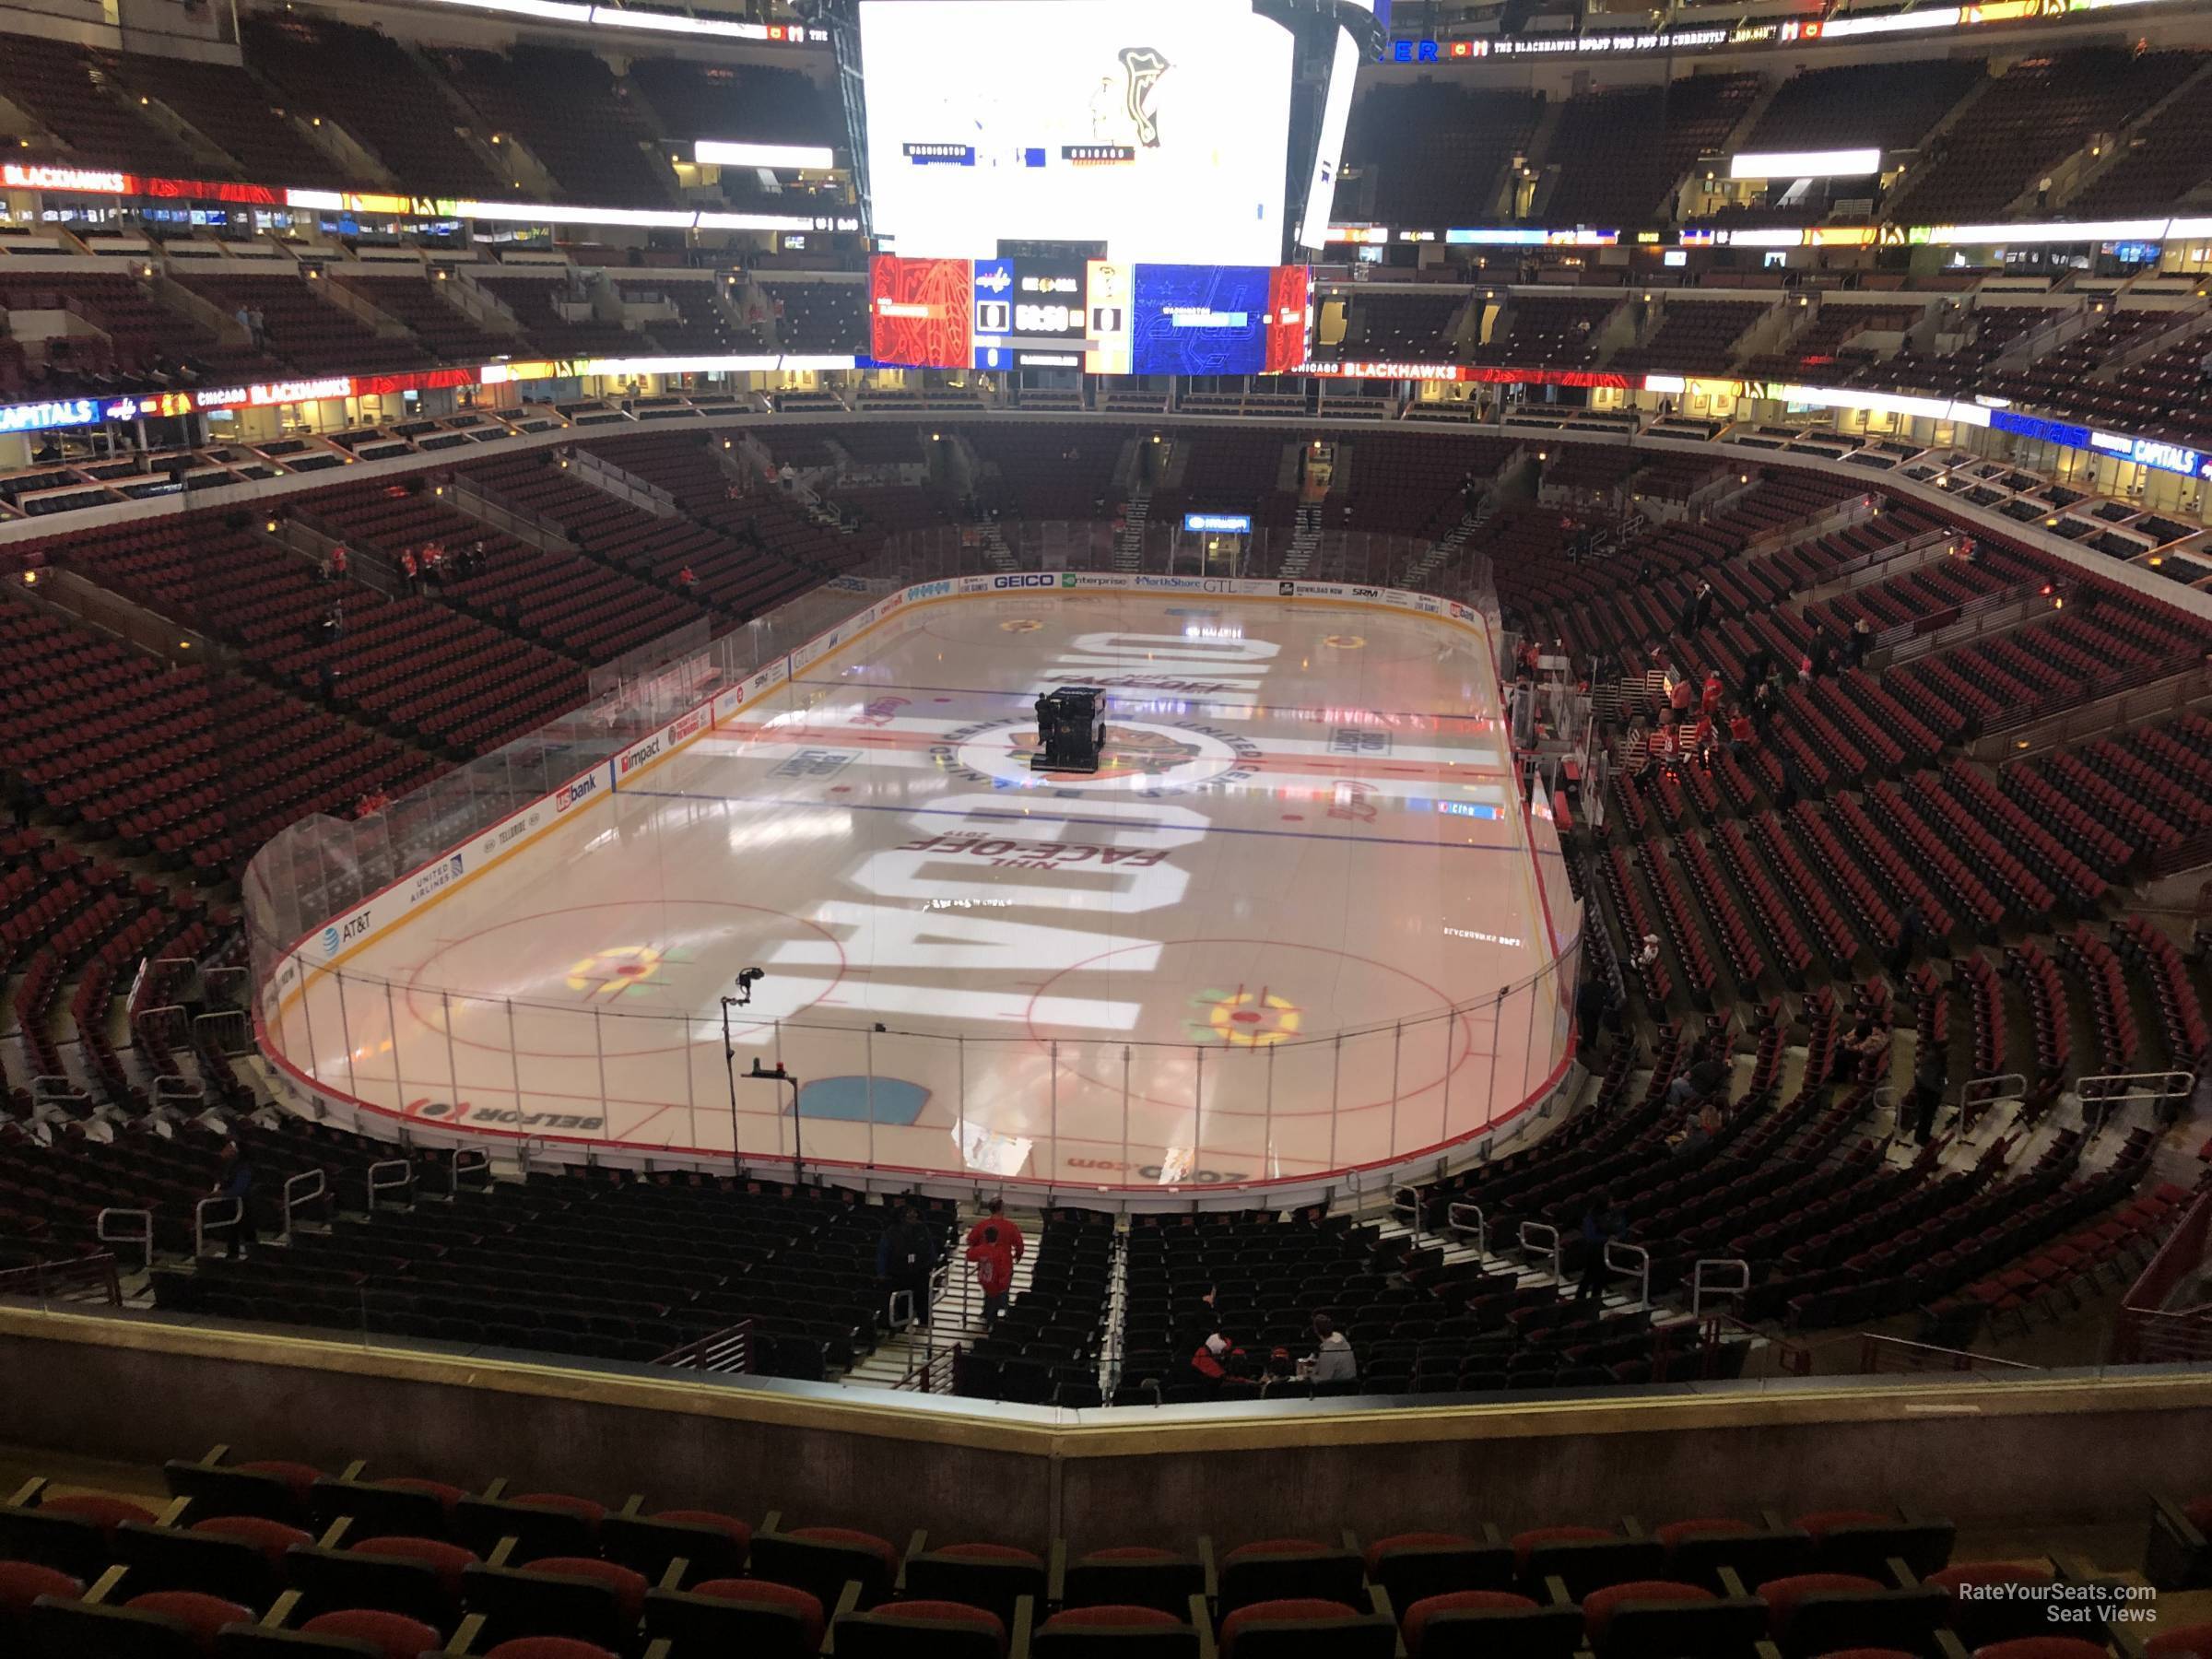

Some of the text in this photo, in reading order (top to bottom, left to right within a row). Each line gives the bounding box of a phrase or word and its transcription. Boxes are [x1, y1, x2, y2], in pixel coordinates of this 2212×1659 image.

[1672, 30, 1726, 46] CURRENTLY
[909, 146, 967, 156] WASHINGTON
[1071, 148, 1124, 159] CHICAGO
[4, 165, 125, 193] BLACKHAWKS
[1344, 362, 1458, 380] BLACKHAWKS
[198, 378, 351, 406] CHICAGO BLACKHAWKS
[2135, 440, 2195, 474] CAPITALS
[994, 575, 1054, 589] GEICO
[1142, 577, 1201, 588] NorthShore
[1204, 580, 1238, 594] GTL
[1352, 589, 1378, 598] SRM
[628, 738, 661, 771] impact
[895, 836, 1171, 866] FACE-OFF
[991, 857, 1060, 870] NHL
[417, 864, 448, 888] UNITED
[410, 874, 450, 902] AIRLINES
[343, 911, 371, 943] AT&T
[472, 1109, 604, 1130] BELFOR
